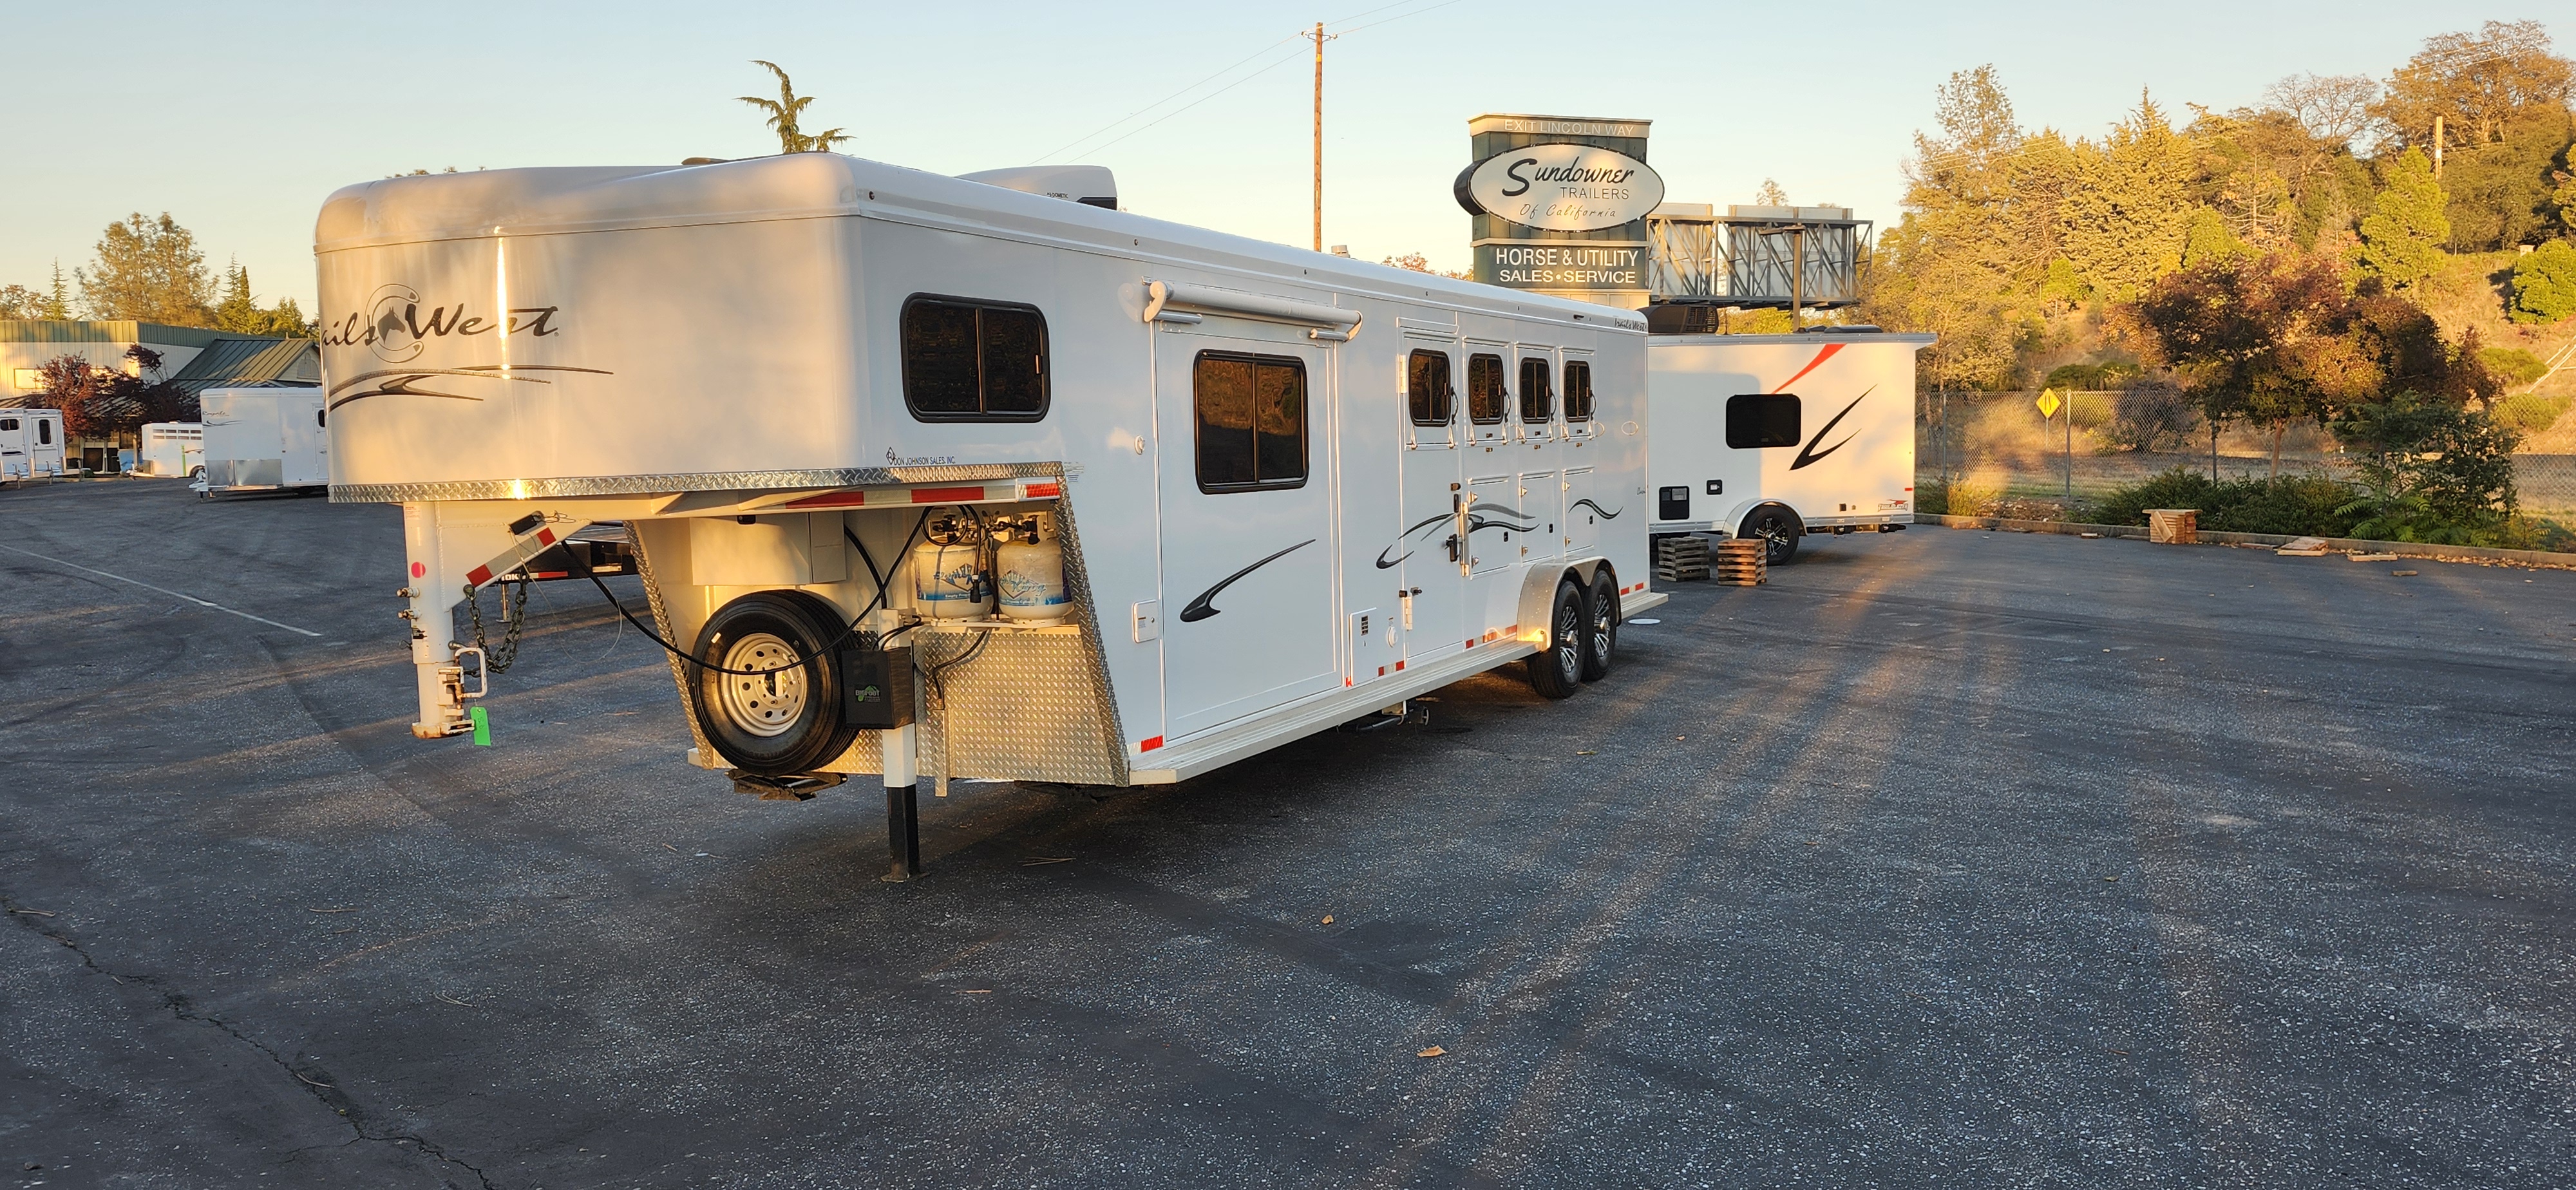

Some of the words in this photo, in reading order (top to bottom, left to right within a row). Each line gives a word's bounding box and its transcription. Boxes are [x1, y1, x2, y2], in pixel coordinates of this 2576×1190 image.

[1504, 120, 1537, 132] EXIT
[1540, 122, 1600, 135] LINCOLN
[1605, 124, 1634, 137] WAY
[1502, 156, 1634, 197] Sundowner
[1560, 187, 1629, 200] TRAILERS
[1519, 203, 1539, 220] Of
[1546, 203, 1616, 220] California
[1496, 248, 1557, 266] HORSE
[1562, 249, 1573, 266] &
[1577, 249, 1638, 267] UTILITY
[894, 457, 905, 466] DON
[905, 457, 929, 466] JOHNSON
